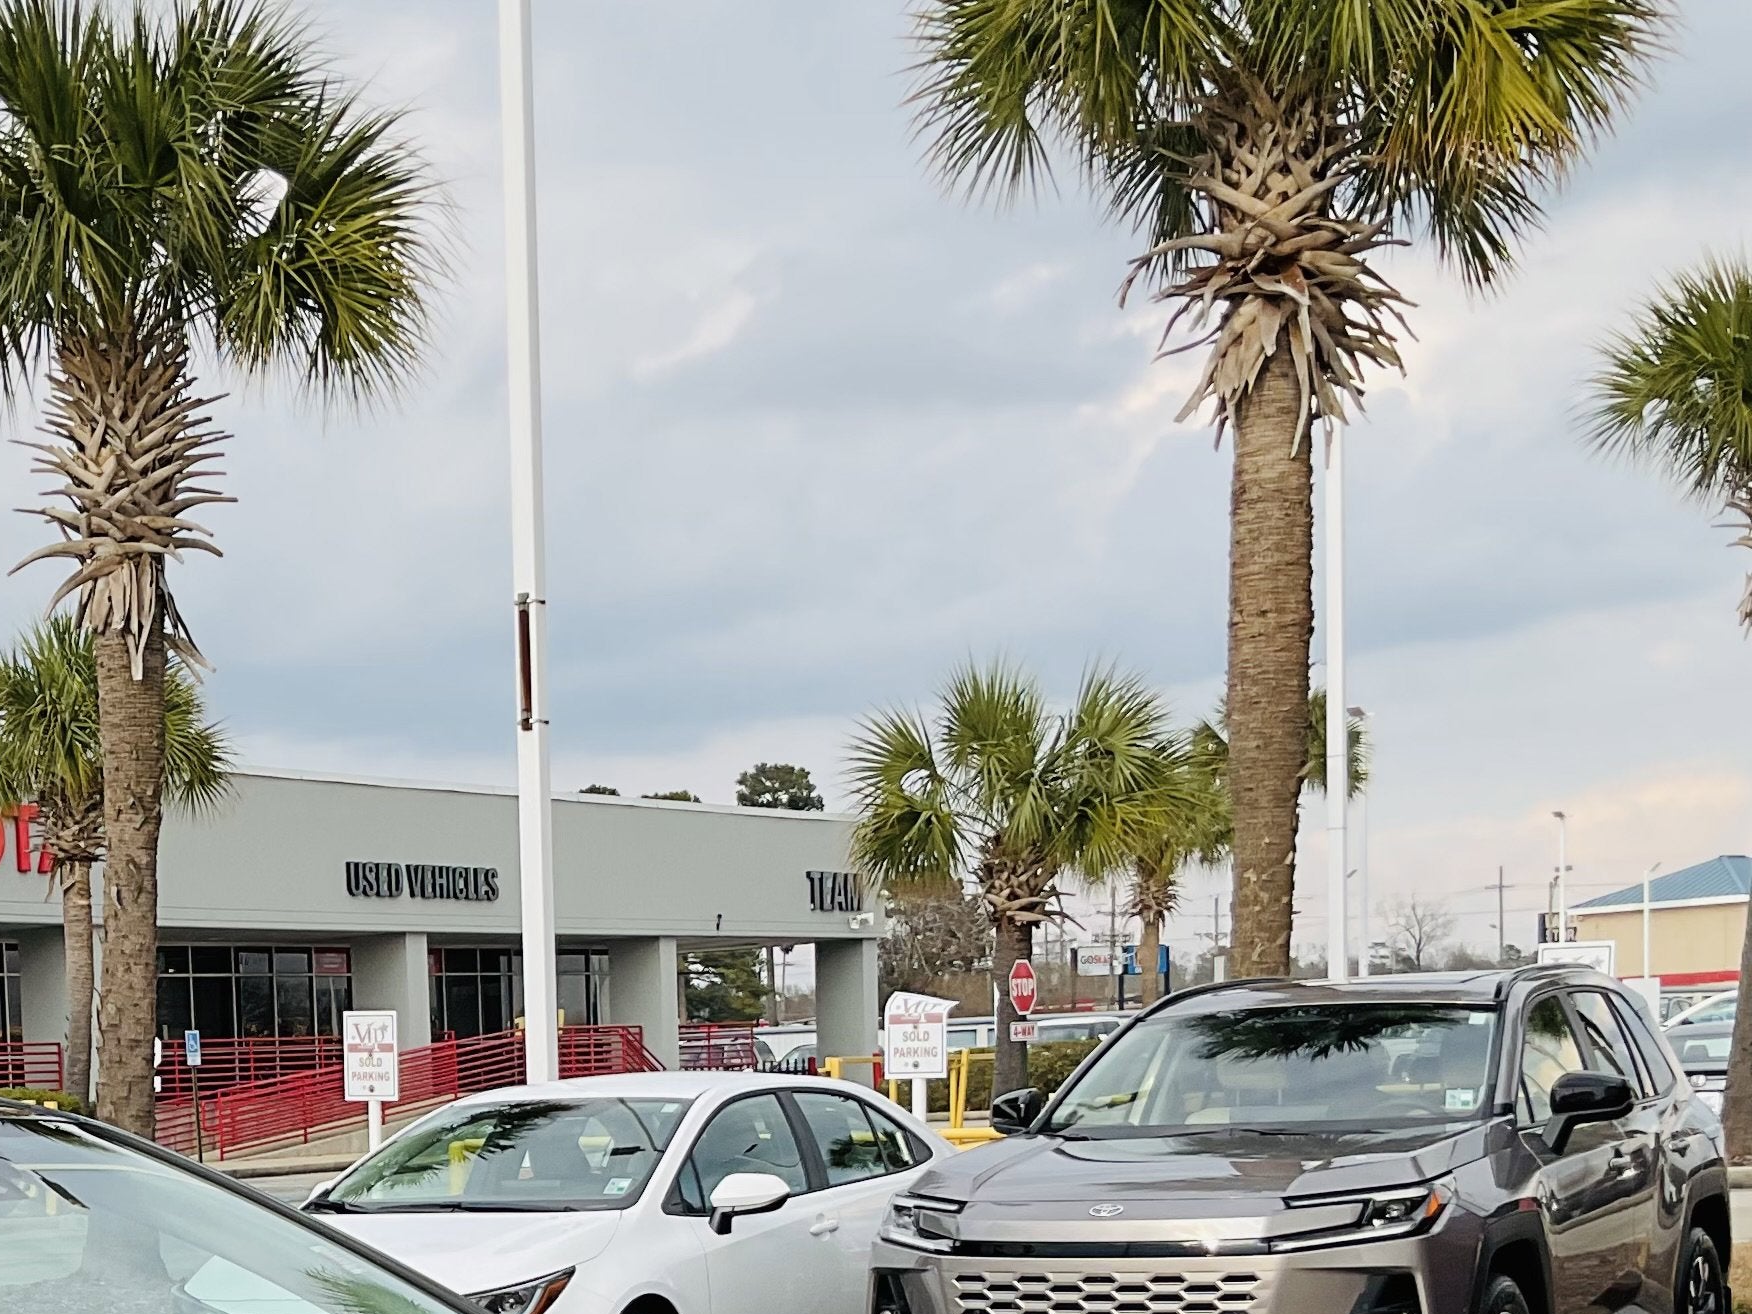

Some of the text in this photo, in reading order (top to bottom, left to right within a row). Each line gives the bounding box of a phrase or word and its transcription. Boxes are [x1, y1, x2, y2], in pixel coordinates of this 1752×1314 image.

[346, 861, 499, 900] USED VEHICLES
[806, 871, 863, 912] TEAM
[1012, 978, 1033, 997] STOP
[902, 1030, 930, 1042] SOLD
[1013, 1026, 1035, 1038] 4-WAY
[893, 1047, 938, 1058] PARKING
[359, 1056, 383, 1068] SOLD
[351, 1071, 391, 1082] PARKING
